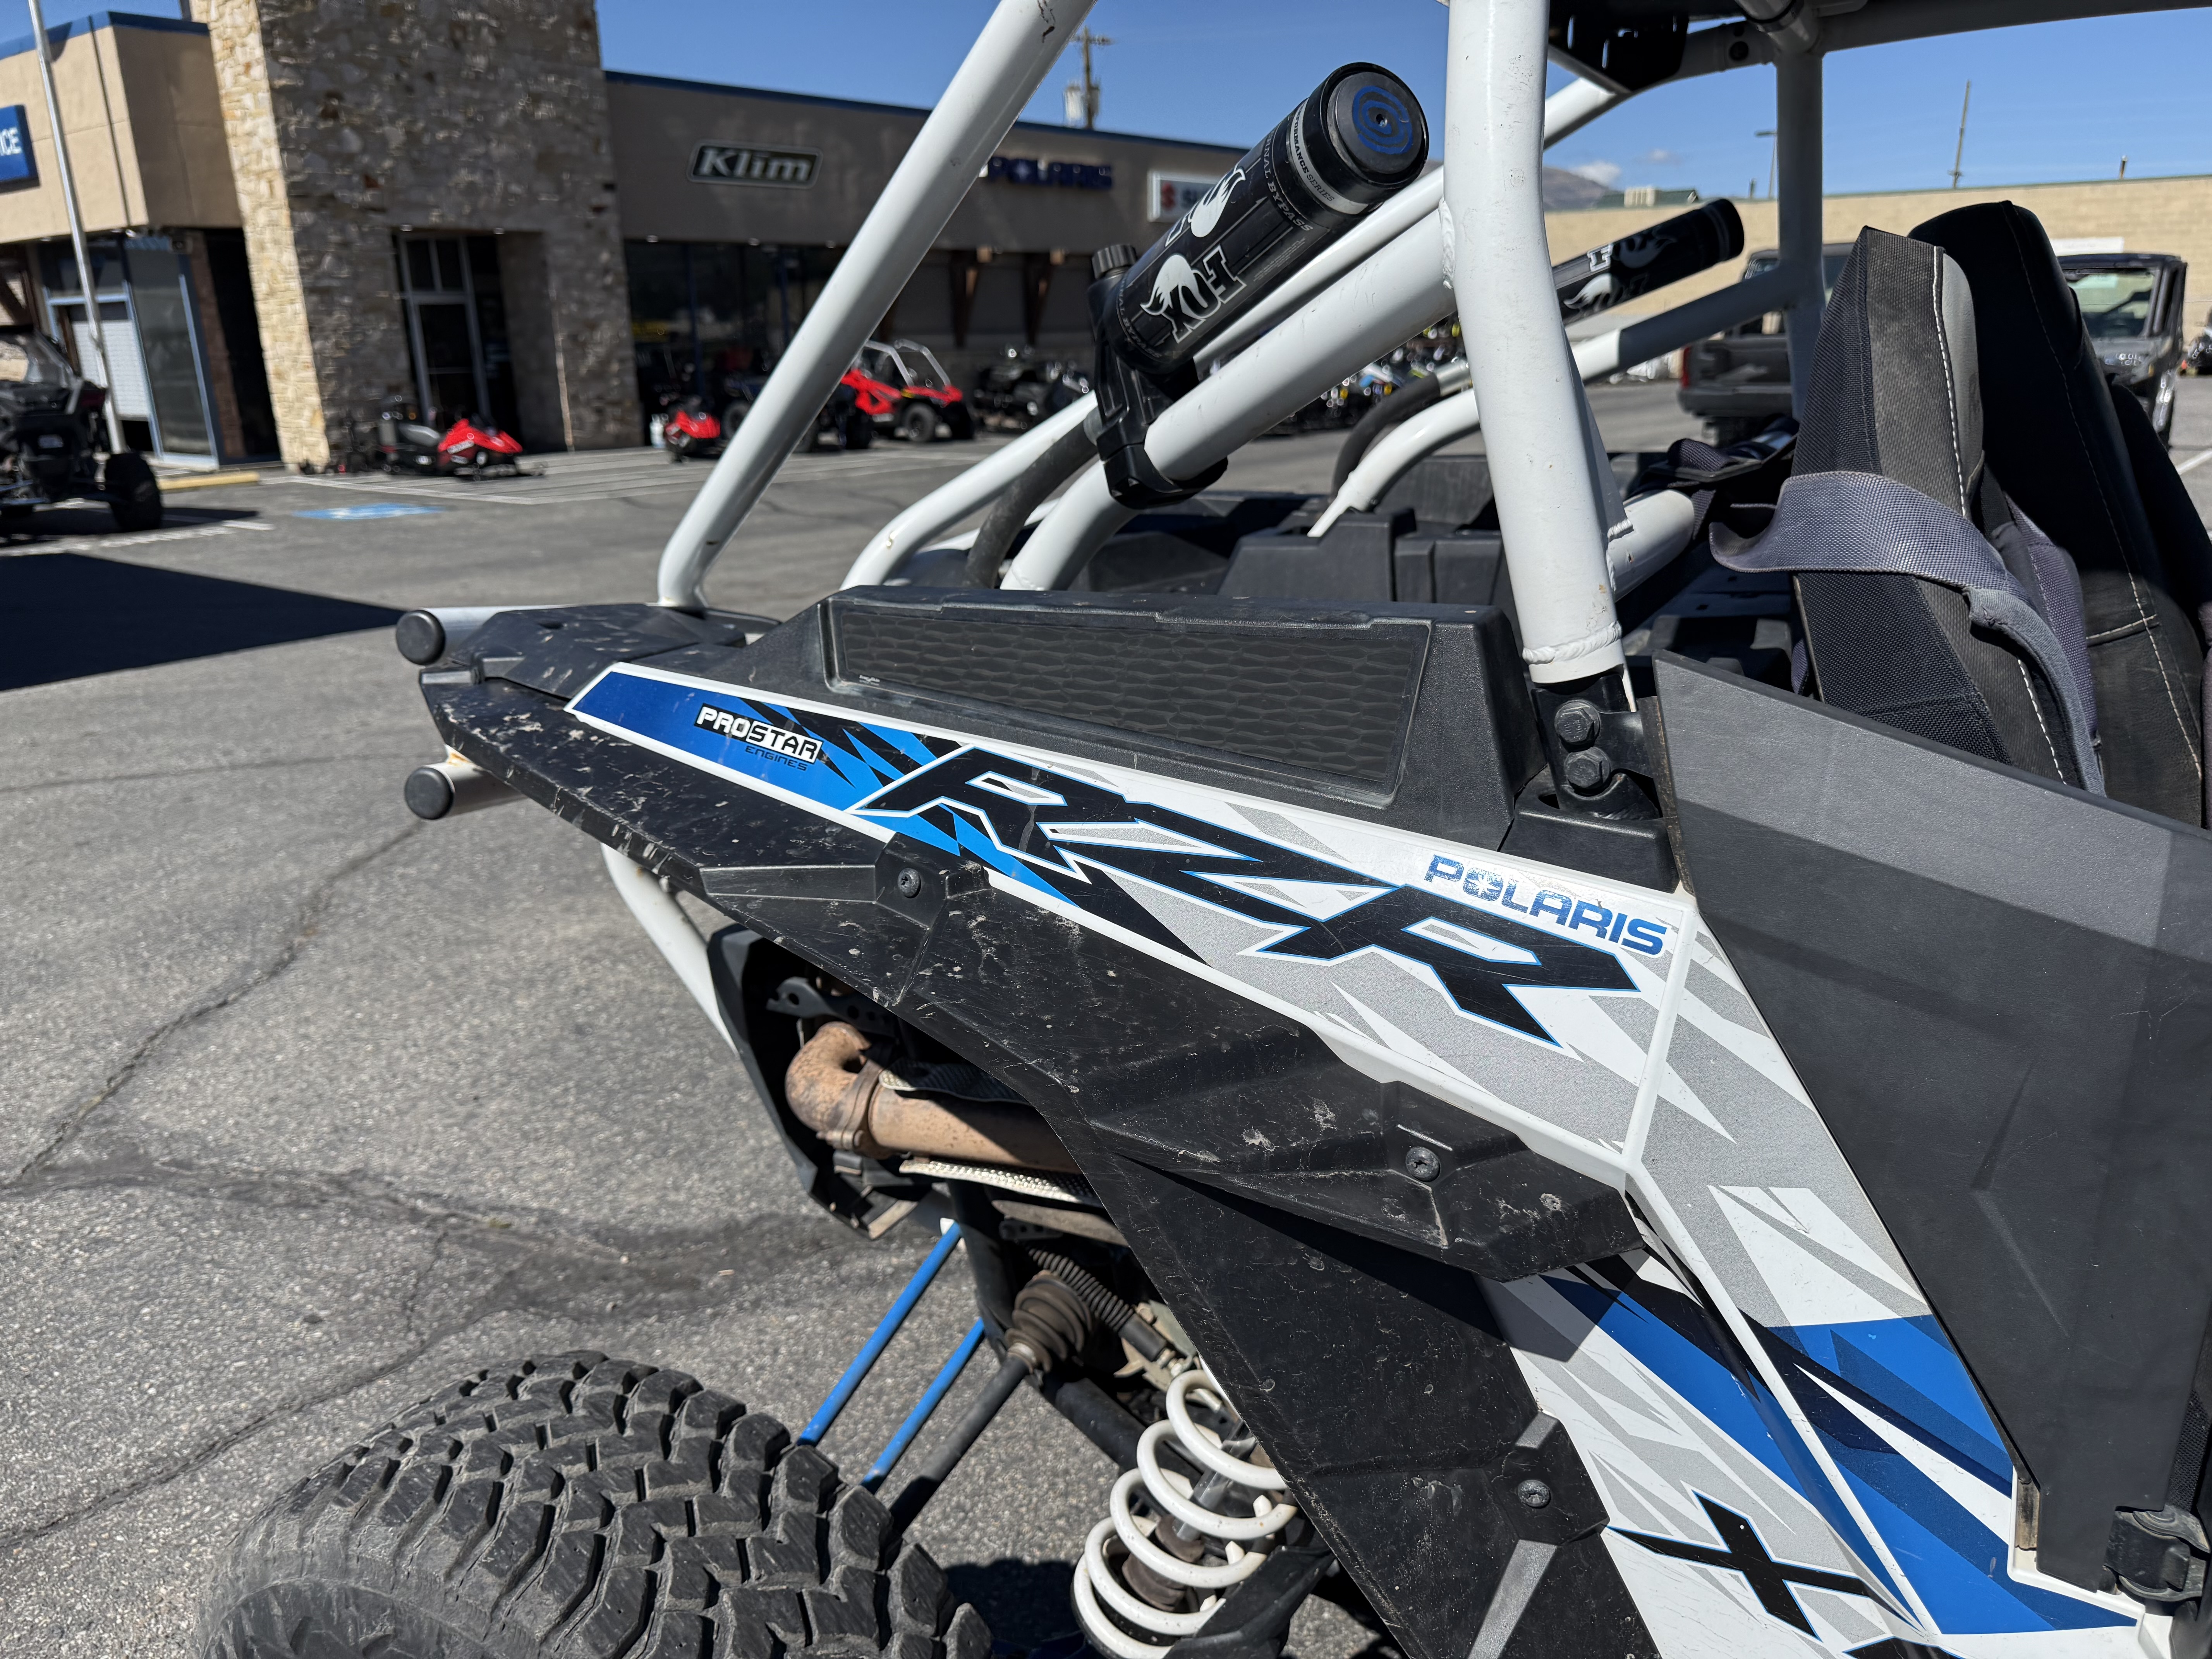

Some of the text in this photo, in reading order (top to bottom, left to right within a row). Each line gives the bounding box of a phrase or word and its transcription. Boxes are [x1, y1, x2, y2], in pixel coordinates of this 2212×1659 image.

[1267, 181, 1314, 231] BYPASS
[1307, 173, 1335, 202] SERIES
[1140, 245, 1247, 344] FOX
[696, 706, 818, 760] PROSTAR
[857, 746, 1640, 1047] RZR
[1424, 855, 1668, 956] POLARIS
